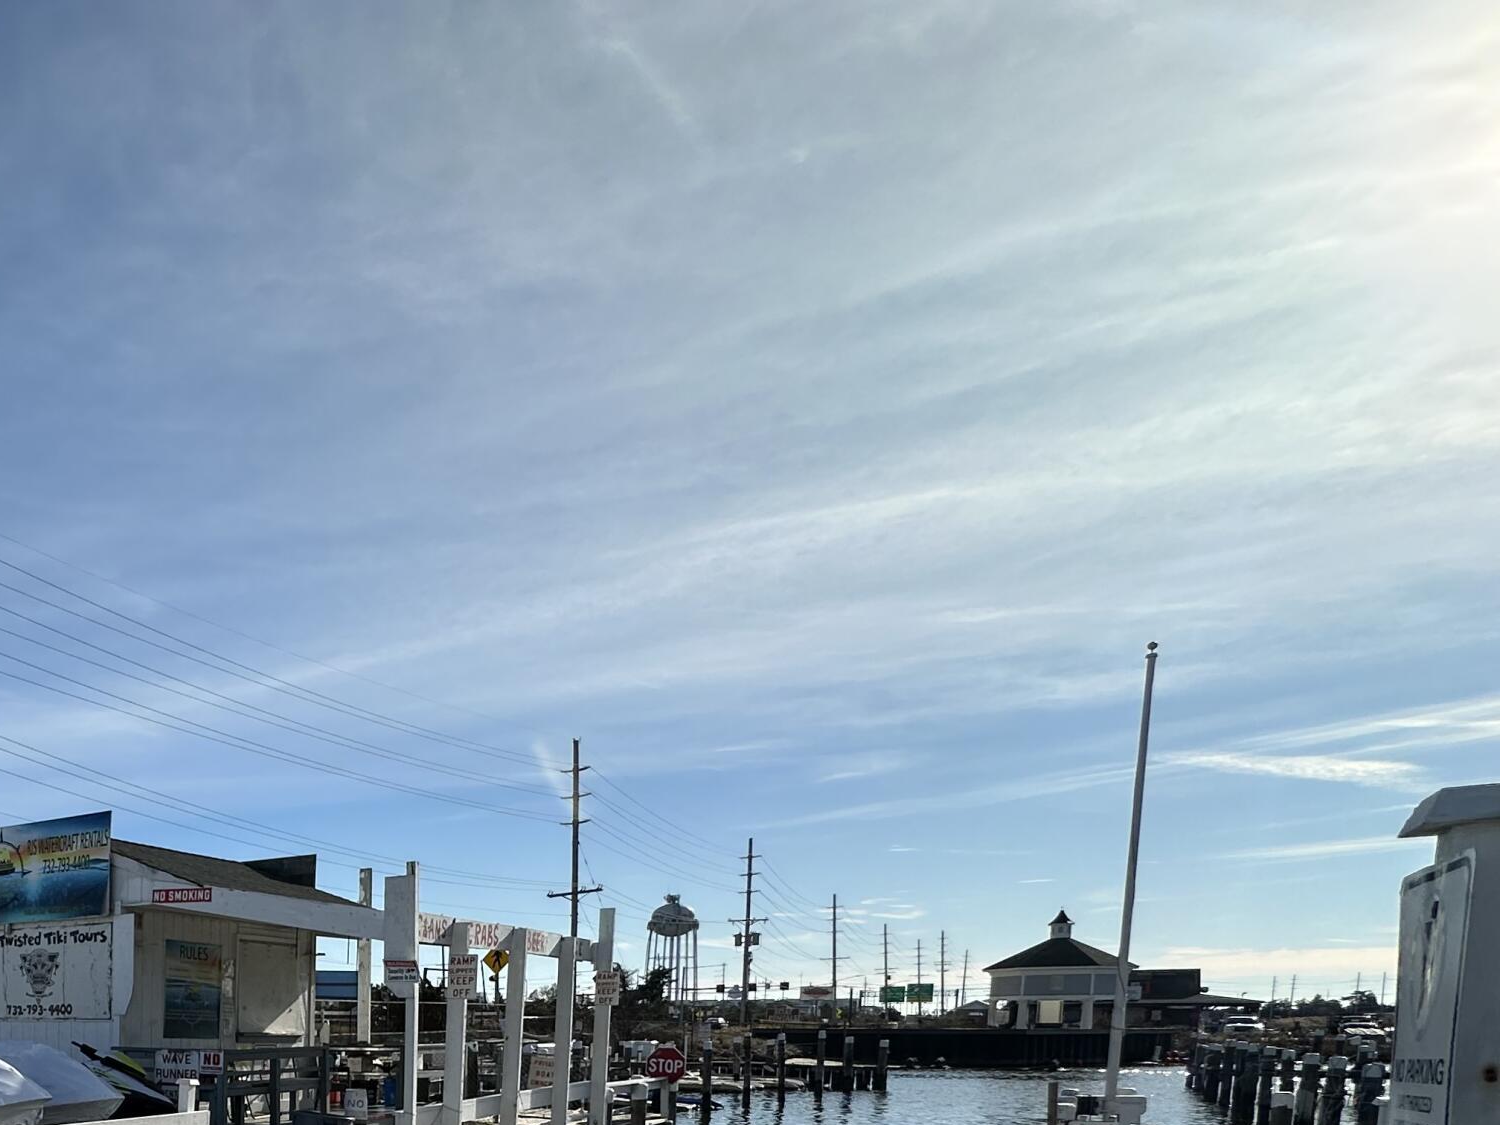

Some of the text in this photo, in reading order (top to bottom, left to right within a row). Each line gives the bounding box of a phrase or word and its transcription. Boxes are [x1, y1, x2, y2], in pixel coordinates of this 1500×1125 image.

[39, 834, 79, 853] WATERCRAFT
[80, 829, 109, 849] RENTALS
[42, 855, 90, 874] 732-793-4400
[154, 889, 210, 901] NO SMOKING
[44, 930, 67, 945] Tiki
[70, 930, 107, 944] Tours
[180, 944, 209, 961] RULES
[450, 957, 475, 966] RAMP
[450, 976, 475, 985] KEEP
[453, 988, 471, 997] OFF
[6, 1004, 73, 1016] 732-793-4400
[162, 1053, 192, 1064] WAVE
[203, 1053, 220, 1065] NO
[648, 1058, 684, 1074] STOP
[1405, 1058, 1444, 1085] PARKING
[155, 1068, 197, 1079] RUNNER
[347, 1100, 365, 1108] NO
